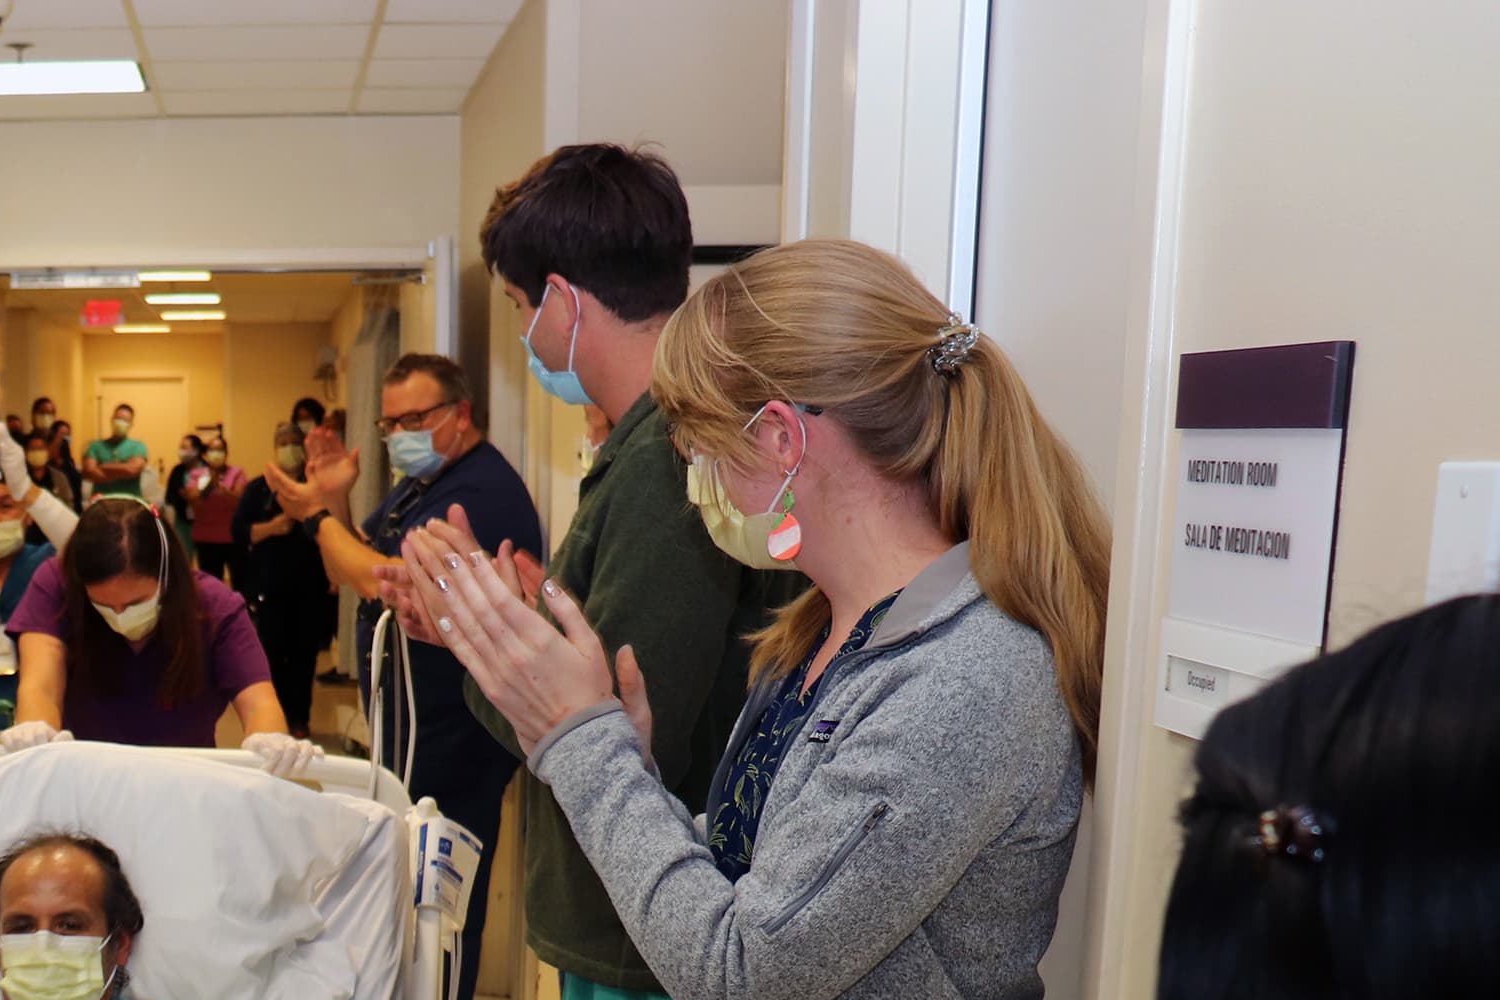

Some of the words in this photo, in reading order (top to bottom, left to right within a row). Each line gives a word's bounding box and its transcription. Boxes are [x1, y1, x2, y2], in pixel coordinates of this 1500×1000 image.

[1187, 459, 1244, 485] MEDITATION
[1246, 462, 1277, 487] ROOM
[1185, 523, 1207, 548] SALA
[1209, 525, 1222, 551] DE
[1224, 526, 1290, 560] MEDITACION
[1187, 670, 1216, 693] Occupied
